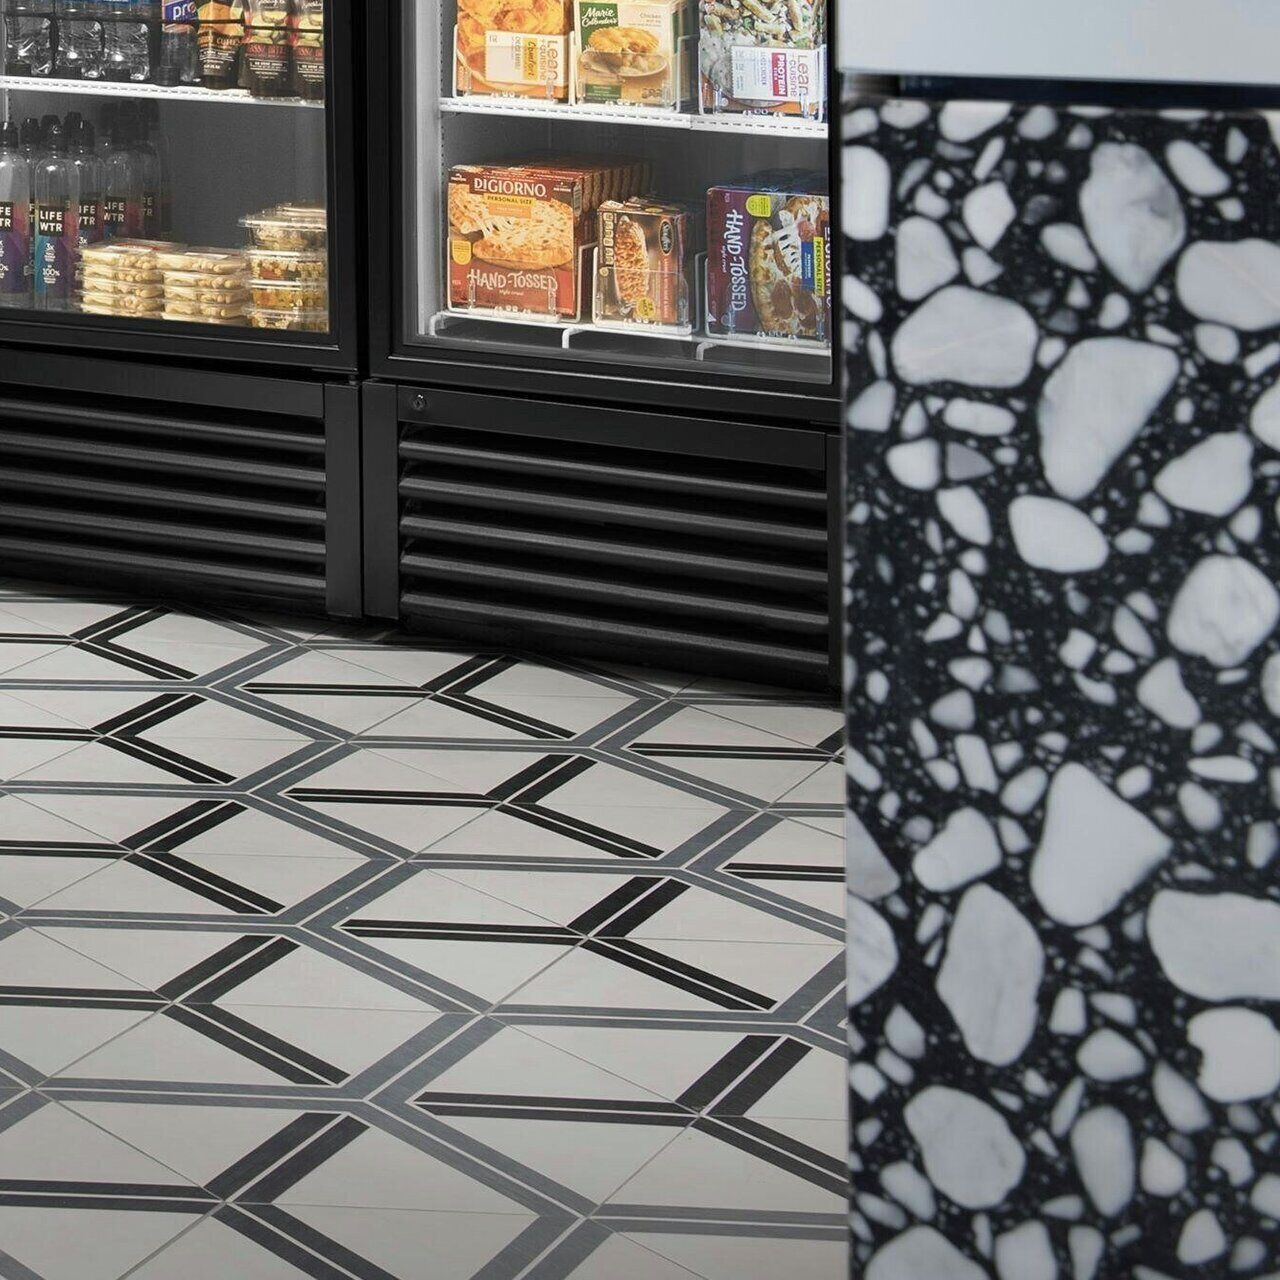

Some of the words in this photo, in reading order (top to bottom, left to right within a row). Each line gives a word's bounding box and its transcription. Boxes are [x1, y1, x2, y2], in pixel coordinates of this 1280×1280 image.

[173, 0, 197, 20] pro
[583, 7, 616, 19] Marie
[581, 17, 618, 27] Callender's
[528, 41, 537, 76] Comfort
[548, 40, 558, 81] Lean
[778, 54, 786, 96] PROTEIN
[790, 60, 798, 97] cuisine
[474, 178, 547, 198] DIGIORNO
[78, 204, 96, 215] IFE
[487, 195, 519, 204] PERSONAL
[40, 209, 63, 221] LIFE
[40, 221, 63, 232] WTR
[46, 243, 55, 251] 3x
[724, 208, 748, 312] HAND-TOSSED
[815, 239, 823, 276] PERSONAL
[42, 268, 61, 276] 100%
[466, 268, 558, 291] HAND-TOSSED
